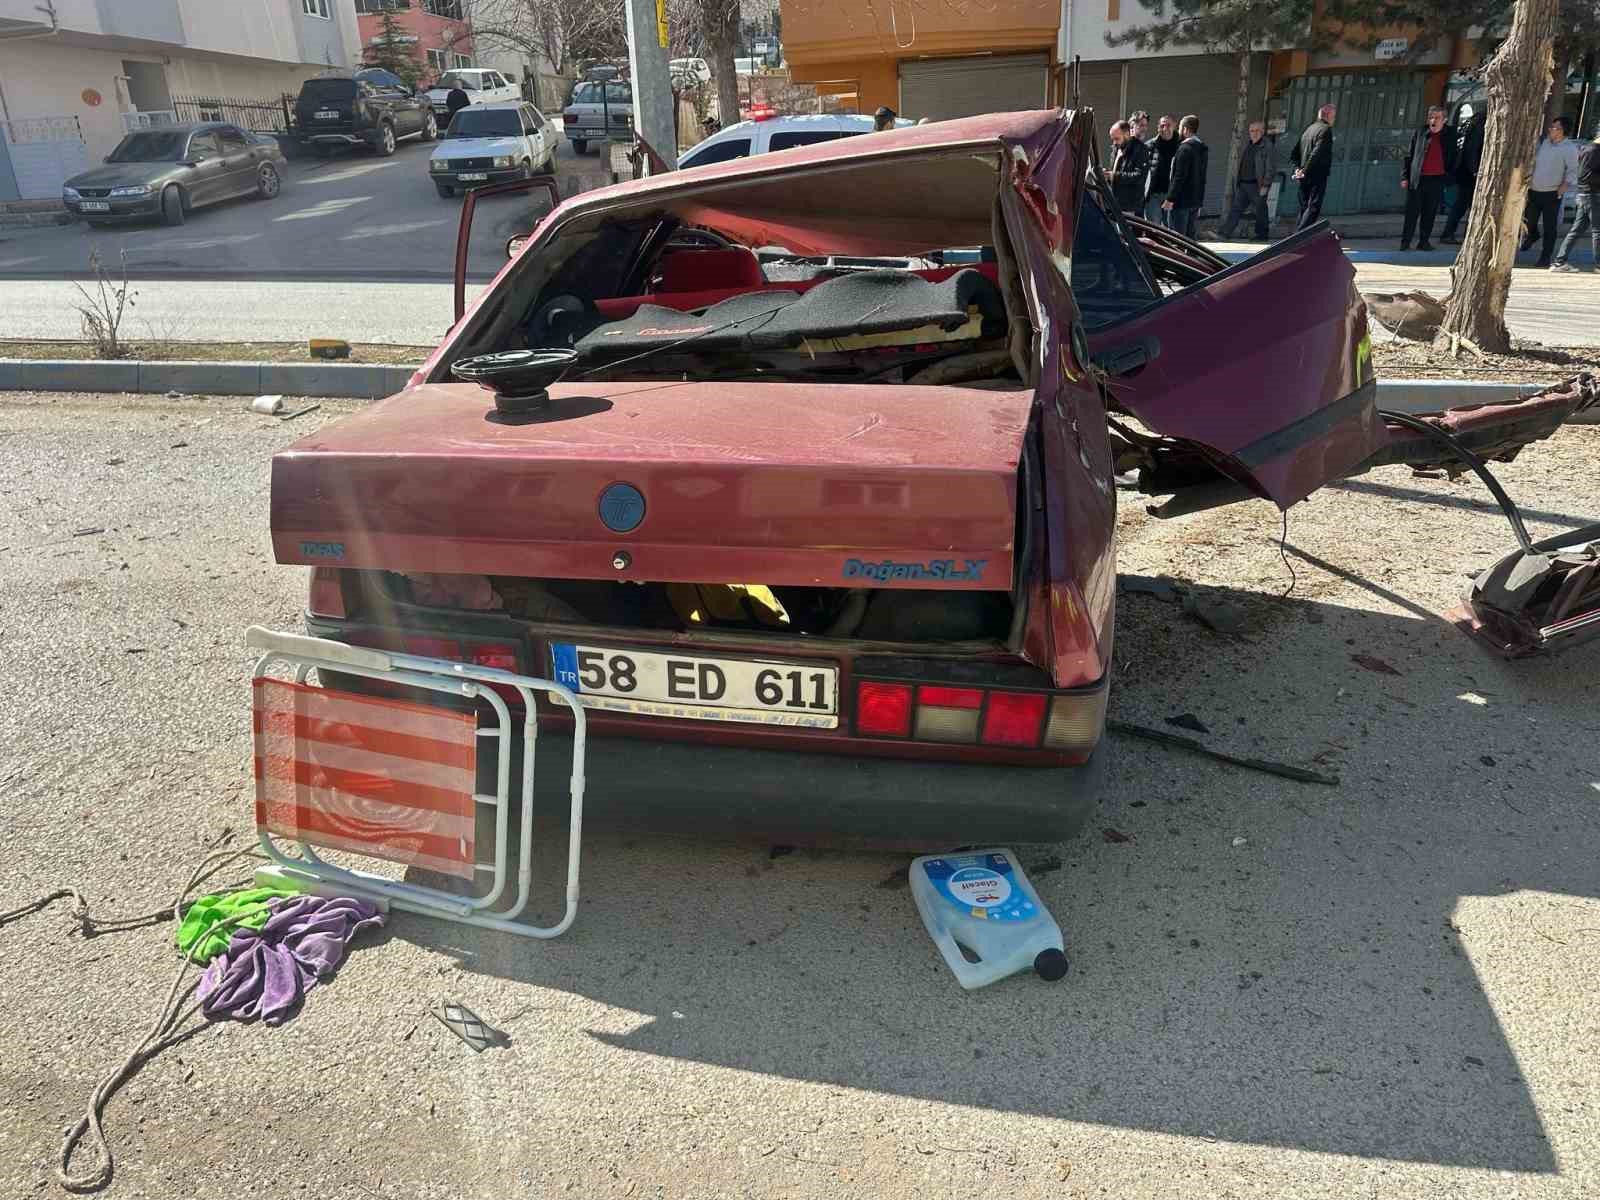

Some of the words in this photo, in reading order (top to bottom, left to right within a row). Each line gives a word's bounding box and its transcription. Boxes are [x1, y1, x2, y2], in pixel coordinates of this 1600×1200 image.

[560, 670, 577, 683] TR
[577, 651, 637, 693] 58
[667, 660, 726, 701] ED
[755, 668, 829, 710] 611
